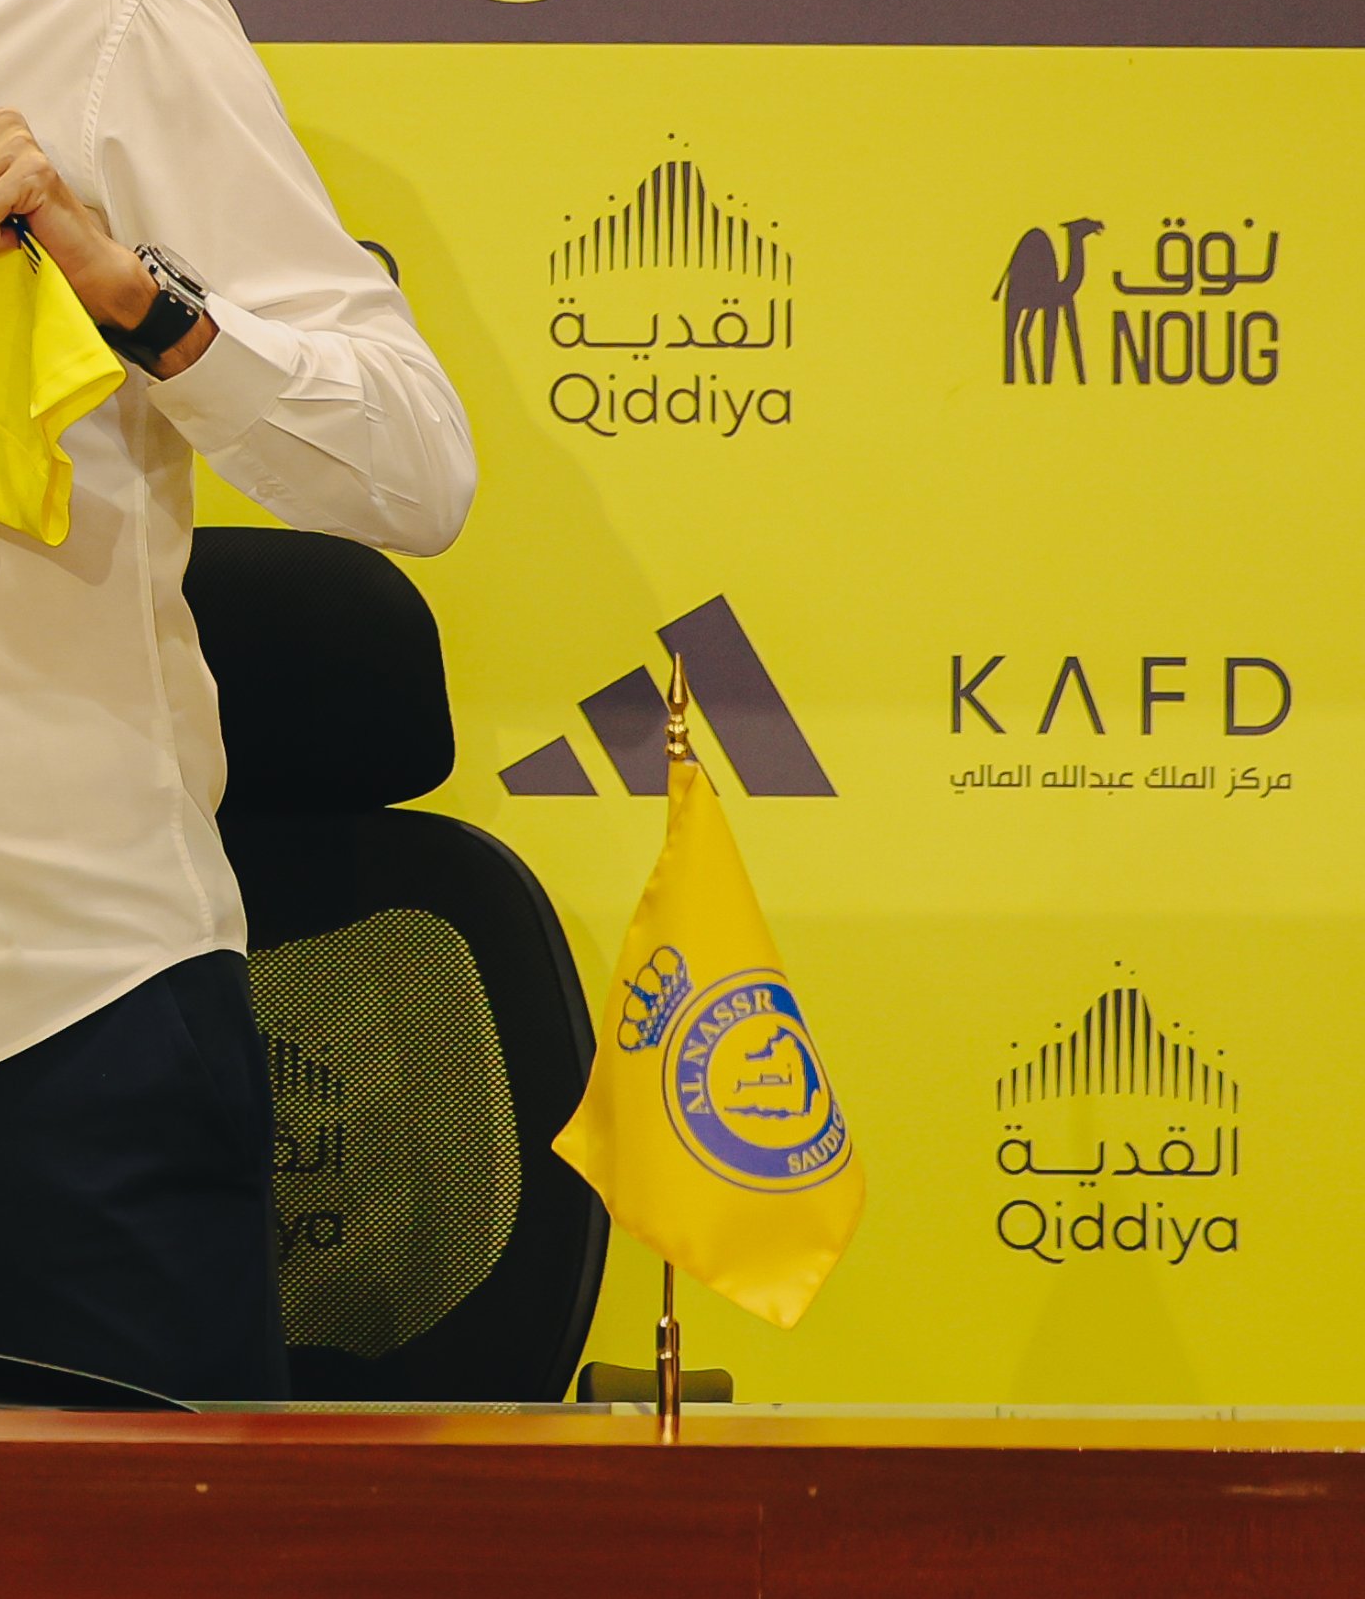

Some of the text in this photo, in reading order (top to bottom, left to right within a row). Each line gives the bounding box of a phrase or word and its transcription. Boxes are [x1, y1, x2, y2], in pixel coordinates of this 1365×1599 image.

[1112, 217, 1279, 297] نوق
[1112, 310, 1279, 386] NOUG
[549, 372, 792, 438] Qiddiya
[951, 654, 1292, 736] KAFD
[949, 764, 1292, 799] مركز الملك عبدالله المالي
[680, 989, 776, 1115] AL NASSR
[996, 1199, 1238, 1266] Qiddiya
